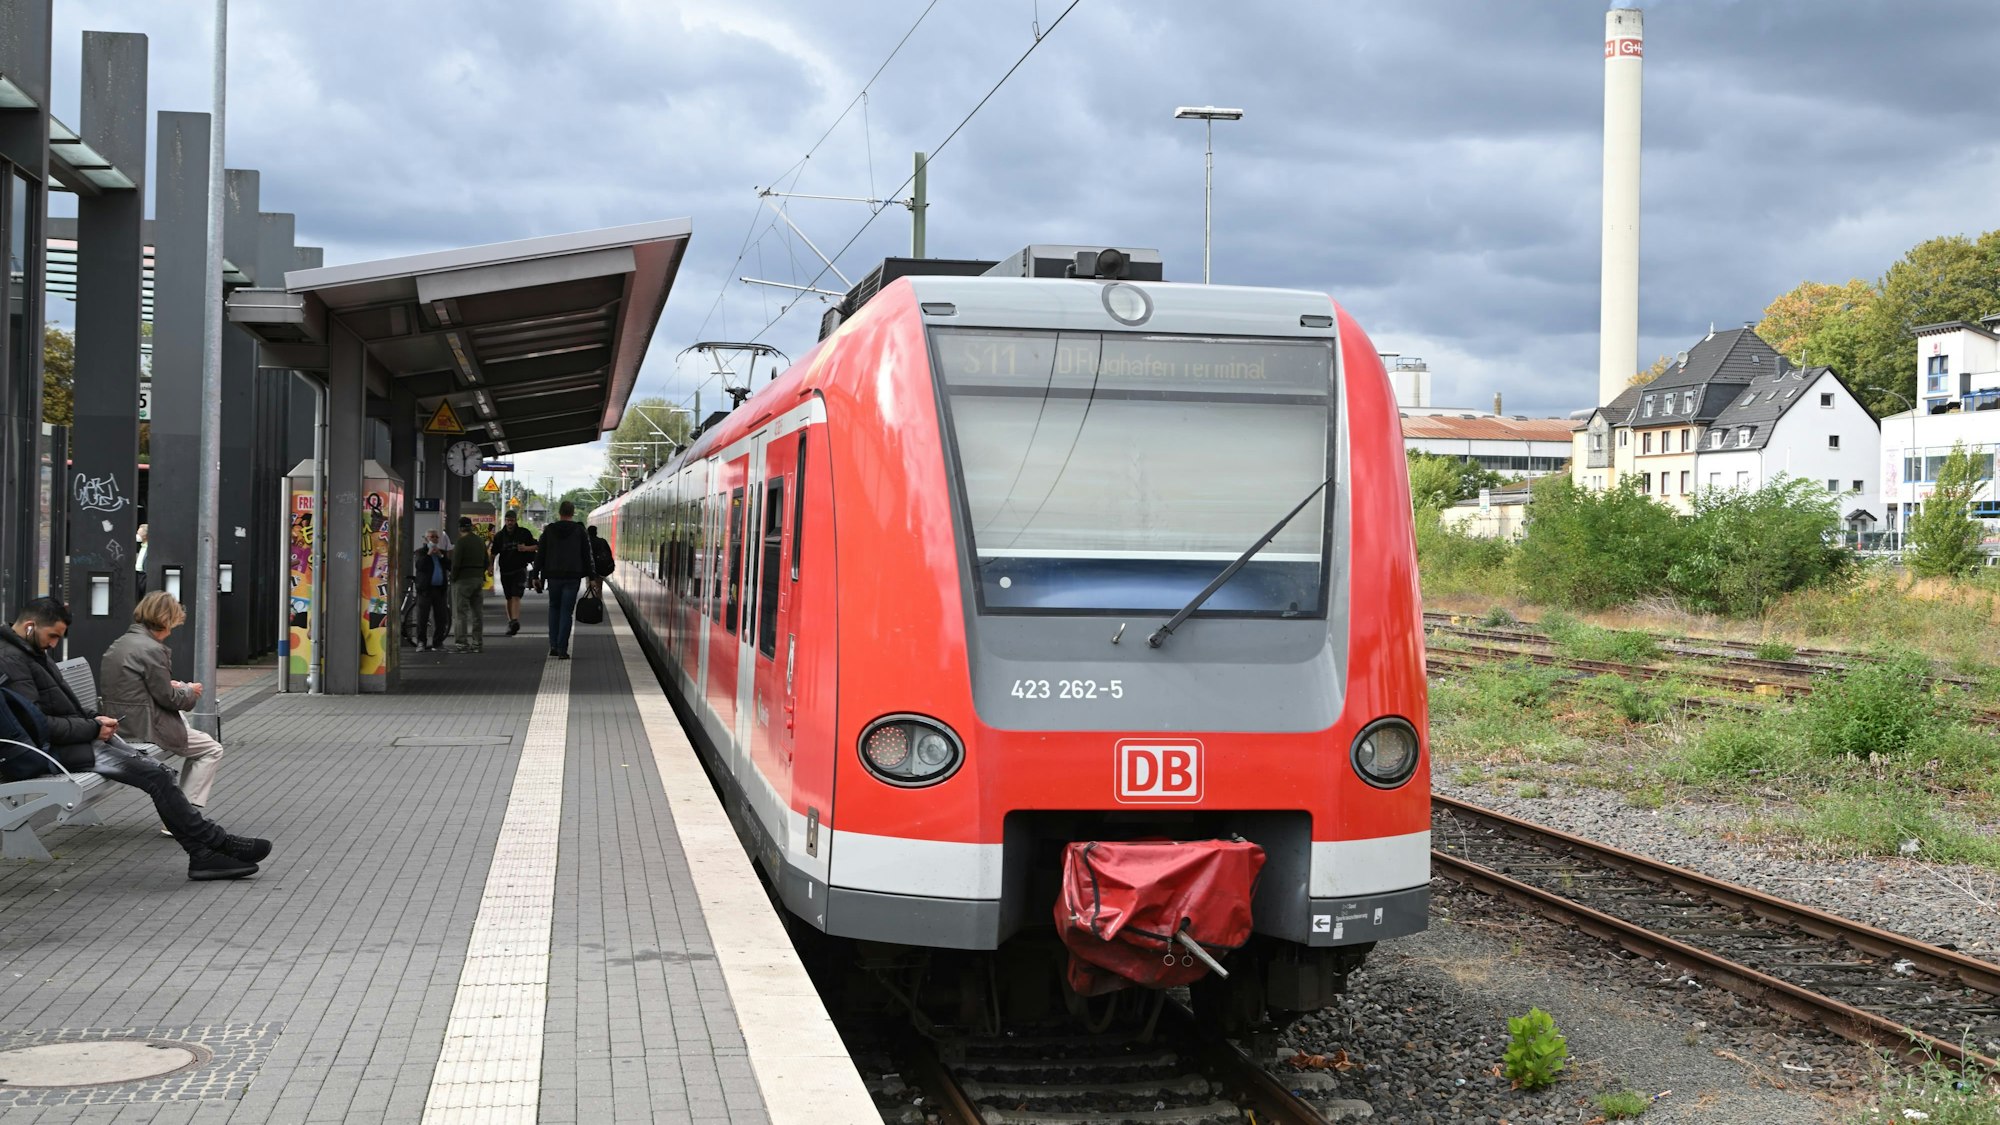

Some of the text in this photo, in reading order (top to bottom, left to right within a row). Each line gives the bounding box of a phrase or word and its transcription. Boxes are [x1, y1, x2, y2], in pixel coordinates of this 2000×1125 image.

[963, 343, 1017, 375] S11
[1011, 680, 1123, 699] 423 262-5
[1127, 750, 1193, 792] DB
